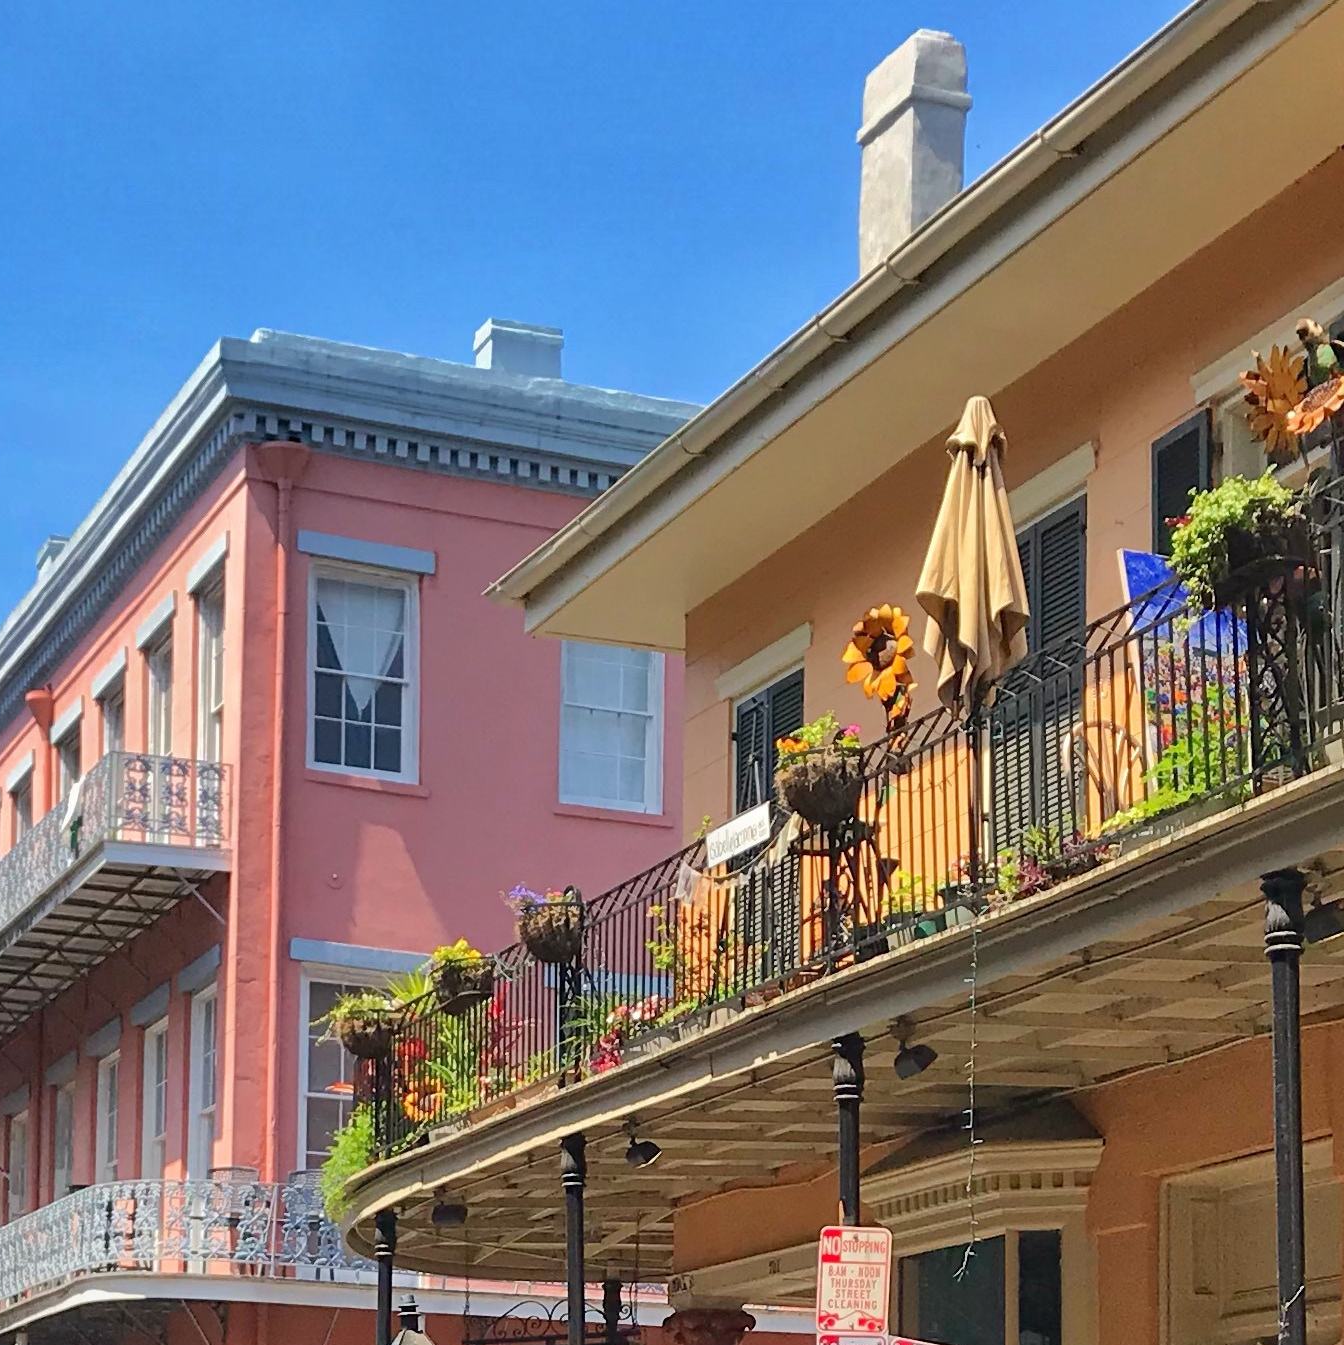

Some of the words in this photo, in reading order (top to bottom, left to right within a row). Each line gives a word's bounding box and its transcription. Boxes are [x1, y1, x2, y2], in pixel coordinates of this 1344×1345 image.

[823, 1236, 840, 1255] NO
[842, 1240, 886, 1254] STOPPING
[858, 1266, 881, 1278] NOON
[830, 1278, 877, 1289] THURSDAY
[835, 1289, 872, 1299] STREET
[827, 1299, 878, 1310] CLEANING
